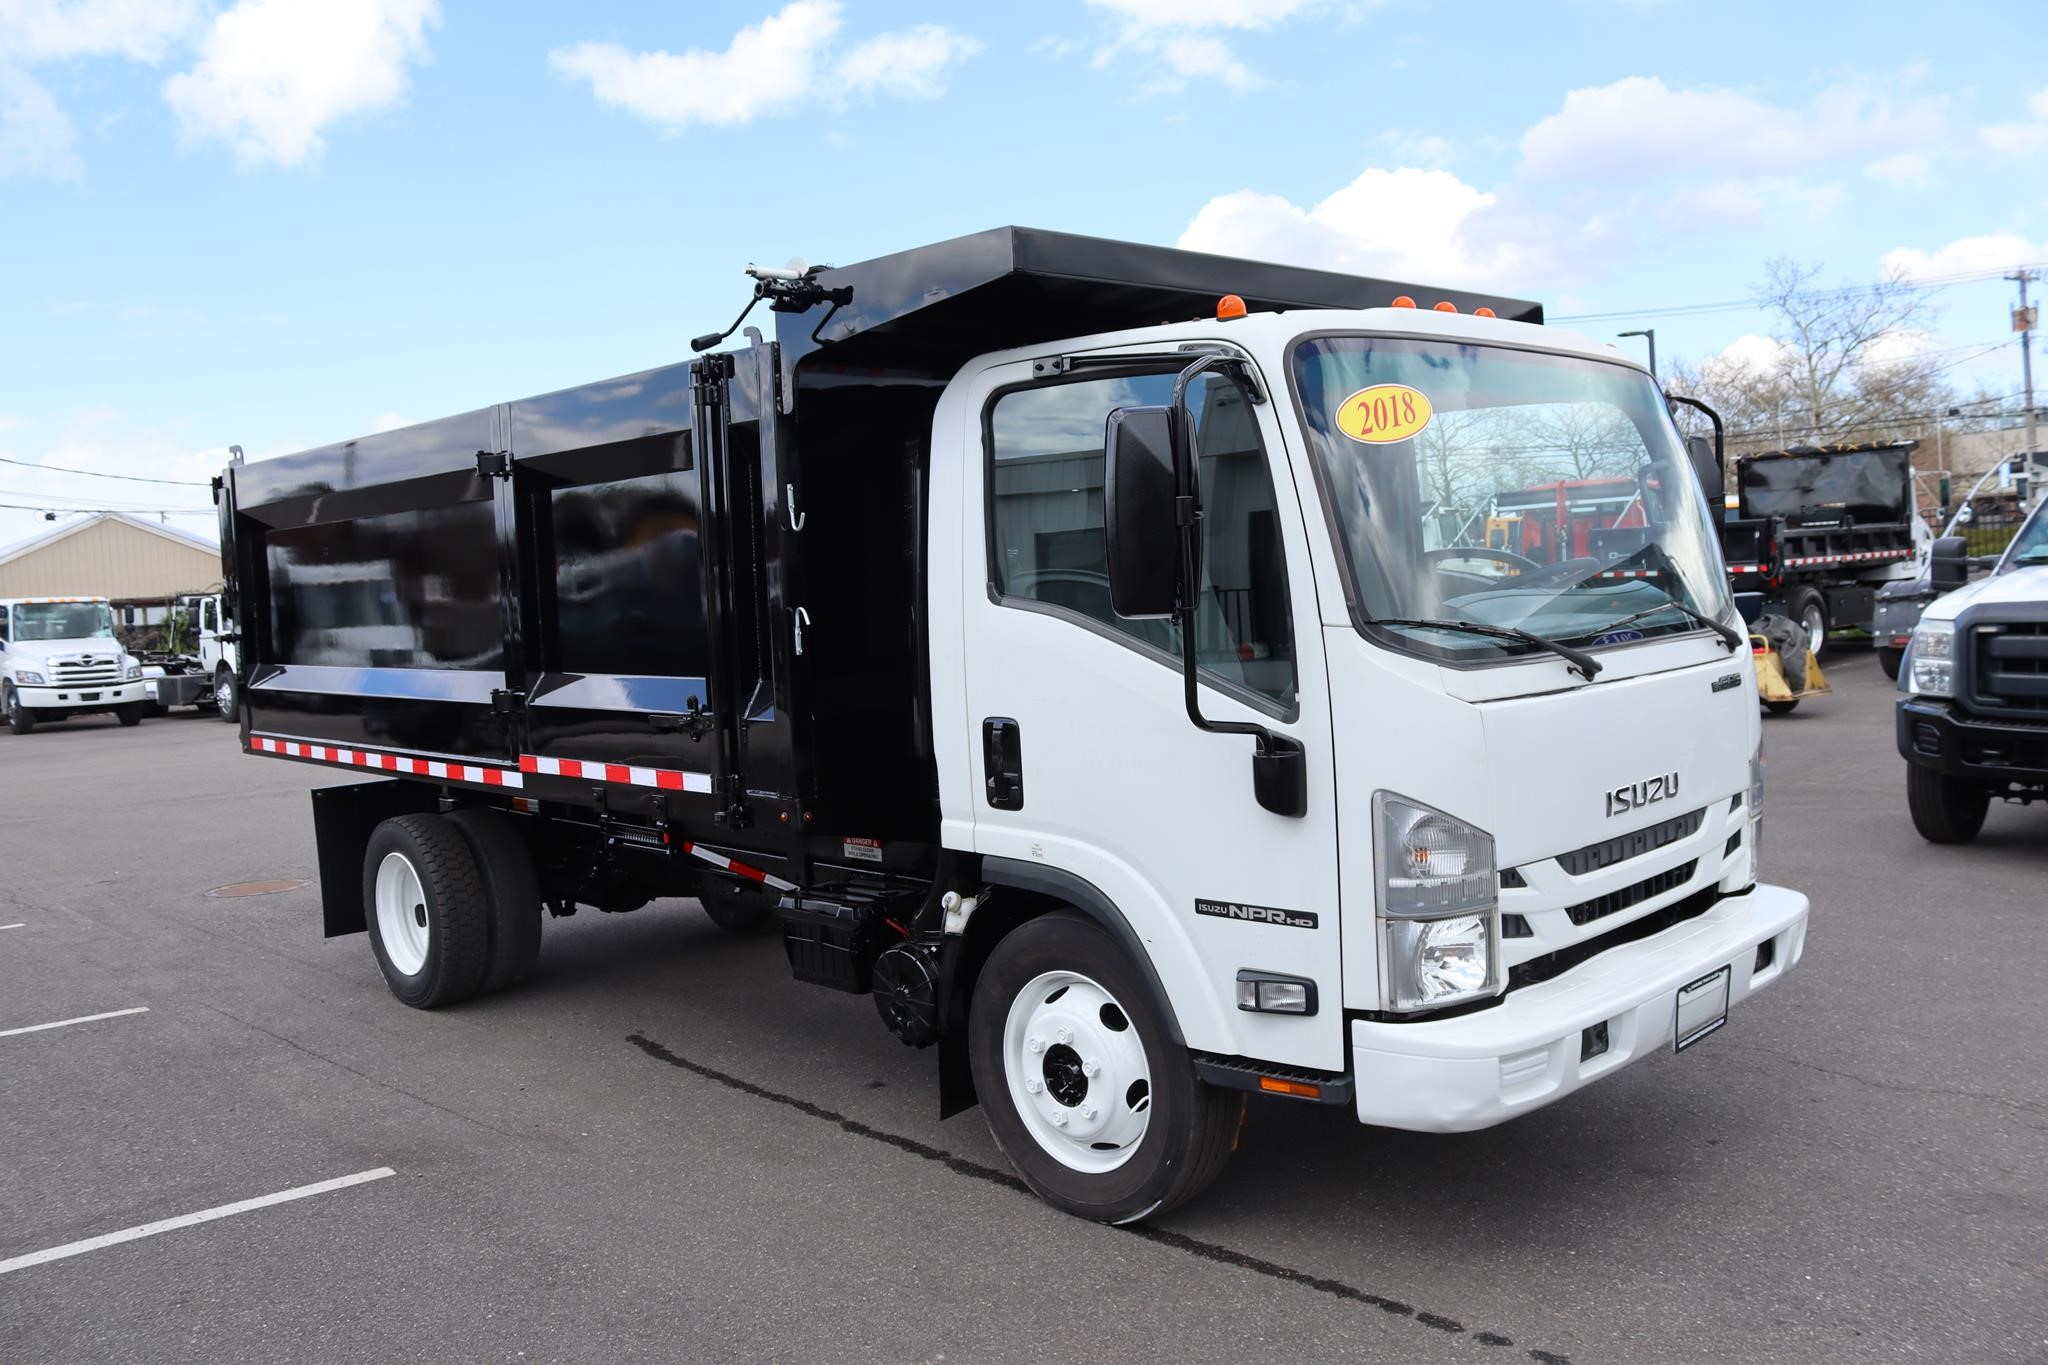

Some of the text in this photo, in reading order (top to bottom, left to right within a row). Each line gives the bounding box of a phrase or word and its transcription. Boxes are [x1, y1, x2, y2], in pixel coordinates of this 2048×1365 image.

[1357, 391, 1417, 436] 2018
[1605, 771, 1680, 819] ISUZU
[851, 837, 873, 846] DANGER
[1198, 903, 1228, 914] ISUZU
[1229, 904, 1285, 924] NPR
